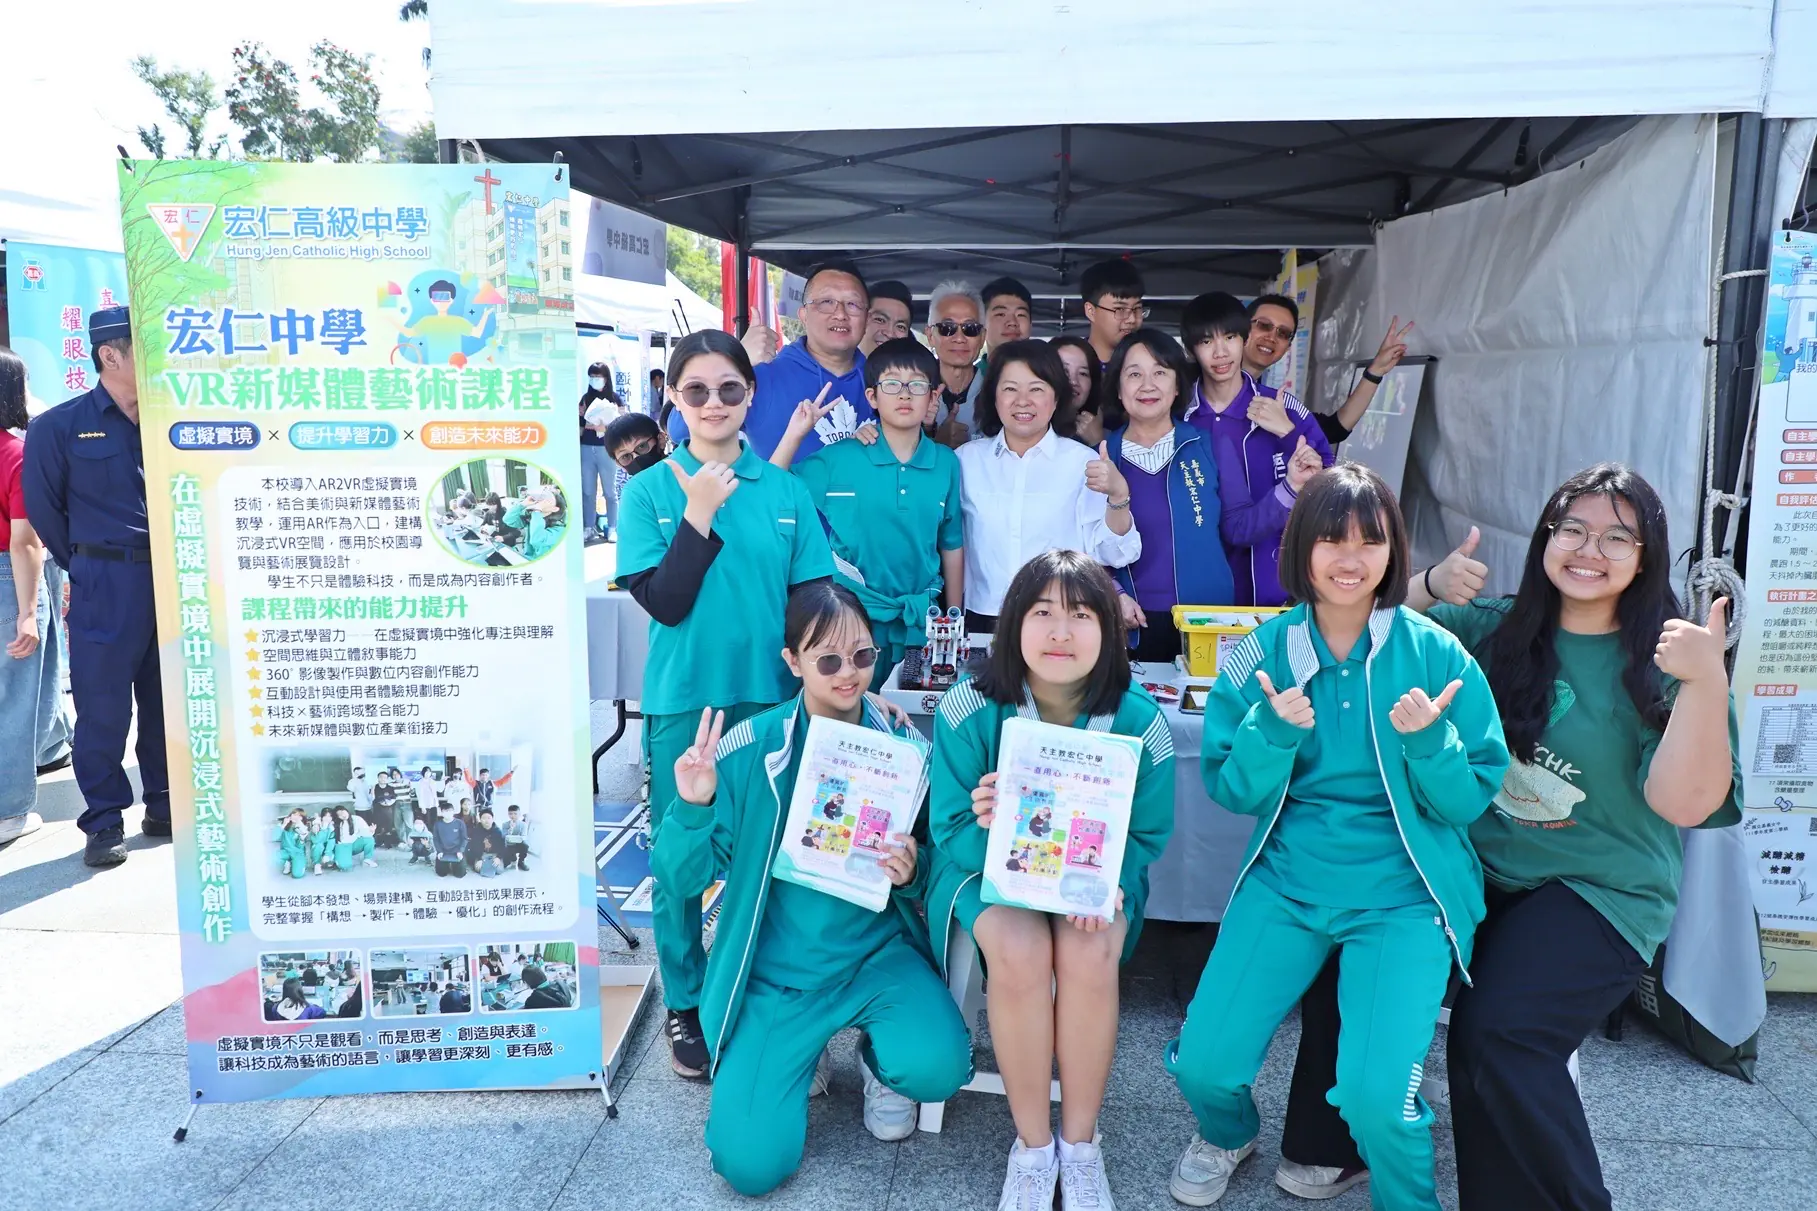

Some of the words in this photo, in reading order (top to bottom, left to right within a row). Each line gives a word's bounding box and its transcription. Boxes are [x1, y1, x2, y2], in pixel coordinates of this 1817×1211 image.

[224, 206, 428, 239] 宏仁高級中學
[227, 245, 261, 259] Hung
[264, 245, 288, 257] Jen
[292, 244, 345, 257] Catholic
[350, 244, 380, 259] High
[383, 244, 428, 257] School
[167, 308, 367, 356] 宏仁中學
[166, 367, 552, 412] VR新媒體藝術課程
[178, 425, 255, 445] 虛擬實境
[296, 425, 389, 445] 提升學習力
[429, 425, 540, 445] 創造未來能力
[261, 477, 418, 491] 本校導入AR2VR虛擬實境
[234, 496, 421, 511] 技術，結合美術與新媒體藝術
[235, 516, 422, 531] 教學，運用AR作為入口，建構
[237, 536, 423, 550] 沉浸式VR空間，應用於校園導
[238, 555, 361, 570] 覽與藝術展覽設計。
[241, 595, 469, 622] 課程帶來的能力提升
[266, 683, 460, 700] 互動設計與使用者體驗規劃能力
[169, 473, 233, 943] 在虛擬實境中展開沉浸式藝術創作
[268, 721, 448, 738] 未來新媒體與數位產業銜接力
[217, 1023, 548, 1052] 虛擬實境不只是觀看，而是思考、創造與表達。
[218, 1041, 564, 1072] 讓科技成為藝術的語言，讓學習更深刻、更有感。
